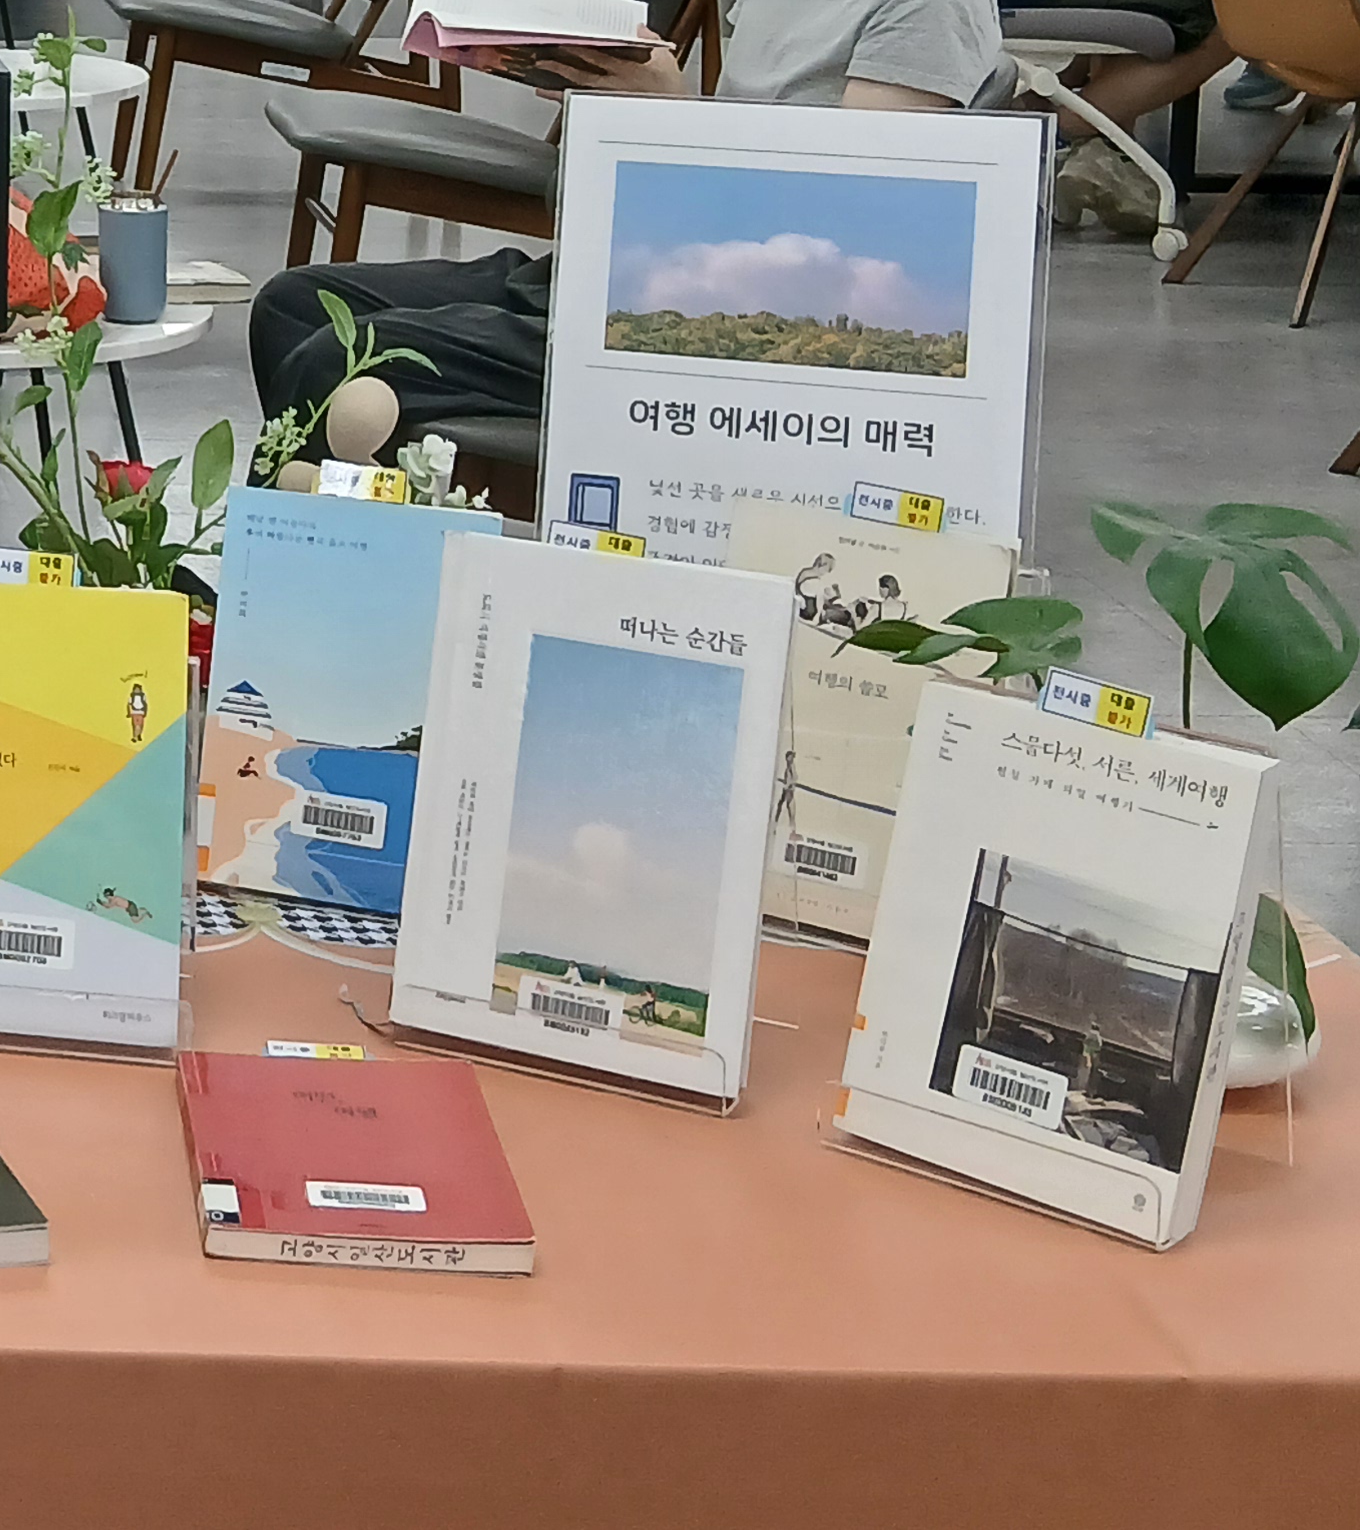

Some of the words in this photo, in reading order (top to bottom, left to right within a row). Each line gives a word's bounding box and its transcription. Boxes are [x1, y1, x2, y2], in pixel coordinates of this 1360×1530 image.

[629, 399, 696, 436] 여행
[710, 404, 849, 449] 에세이의
[865, 418, 936, 458] 매력
[620, 615, 678, 646] 떠나는
[685, 628, 747, 657] 순간들
[1109, 691, 1136, 711] 대출
[1148, 768, 1229, 808] 세계여행
